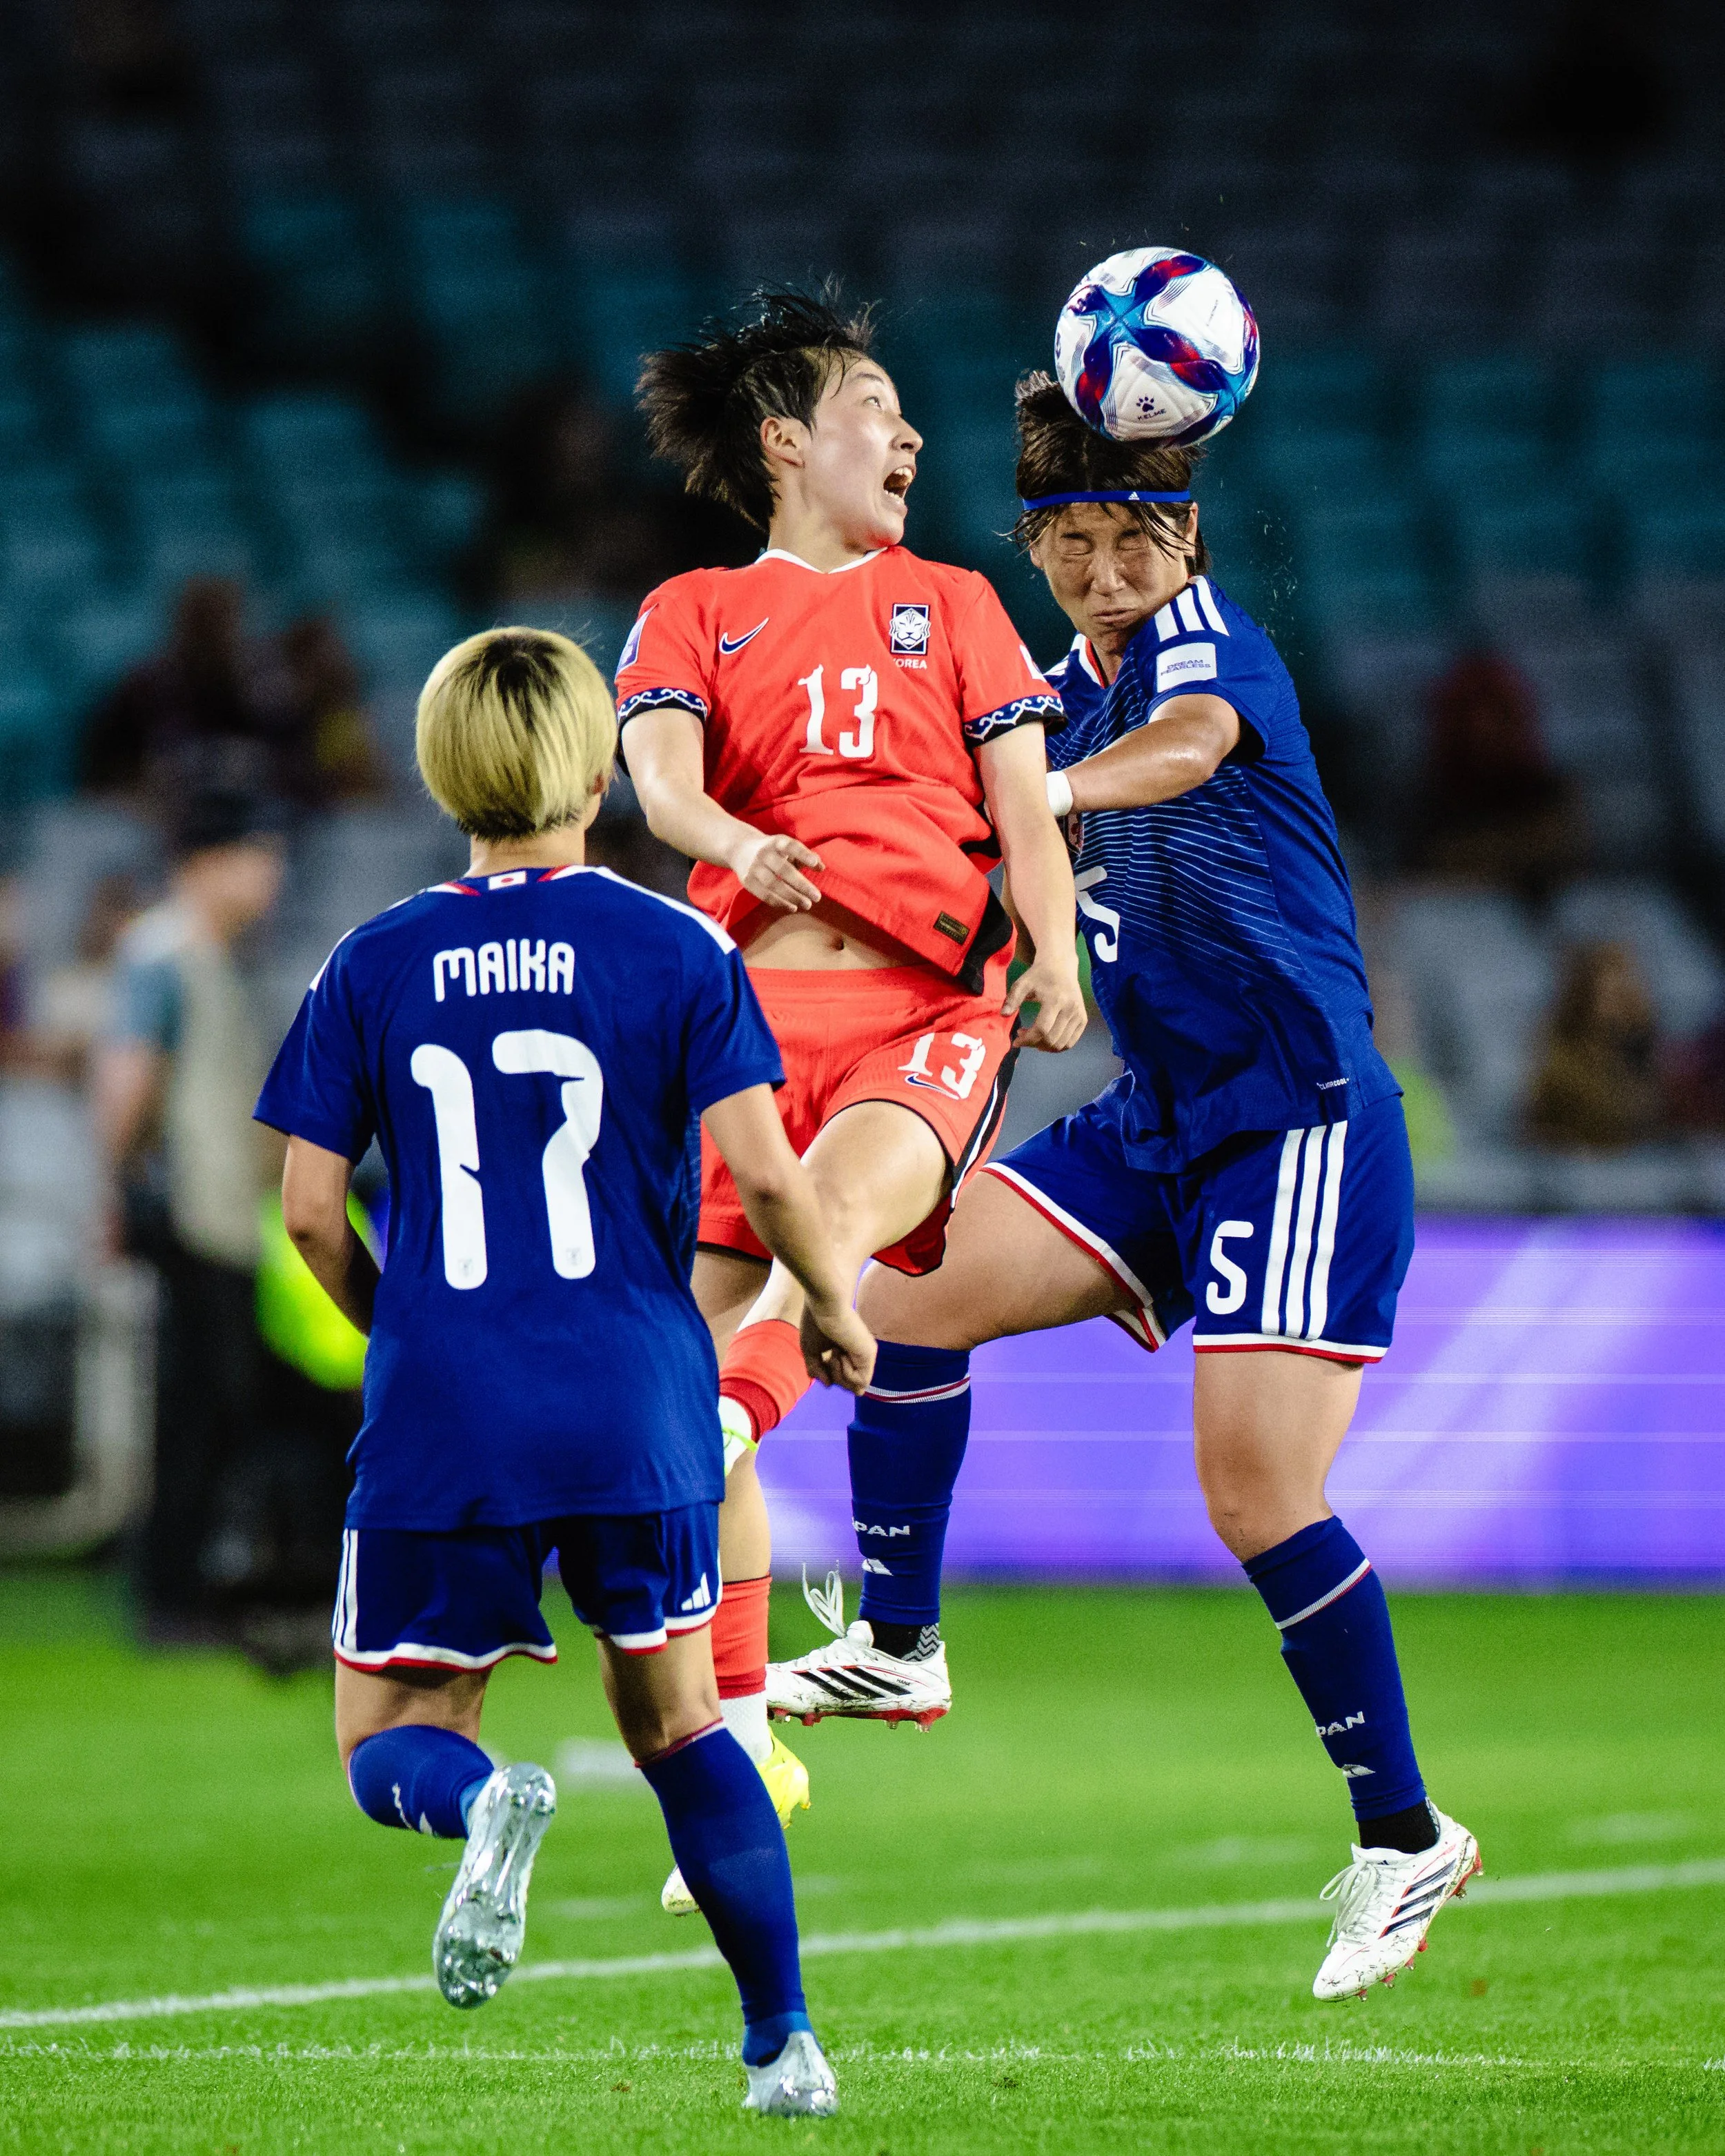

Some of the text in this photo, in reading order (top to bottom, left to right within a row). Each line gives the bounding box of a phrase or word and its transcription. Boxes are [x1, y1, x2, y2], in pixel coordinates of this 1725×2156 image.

[1137, 409, 1166, 420] KELME
[894, 658, 928, 669] OREA
[1161, 663, 1211, 676] FEARLESS
[1167, 660, 1203, 669] DREAM
[797, 664, 878, 758] 13
[1074, 865, 1121, 963] 5
[433, 938, 575, 1002] MAIKA
[897, 1032, 987, 1099] 13
[411, 1029, 604, 1290] 17
[1206, 1220, 1254, 1315] 5
[852, 1516, 910, 1537] PAN
[1314, 1710, 1366, 1738] PAN
